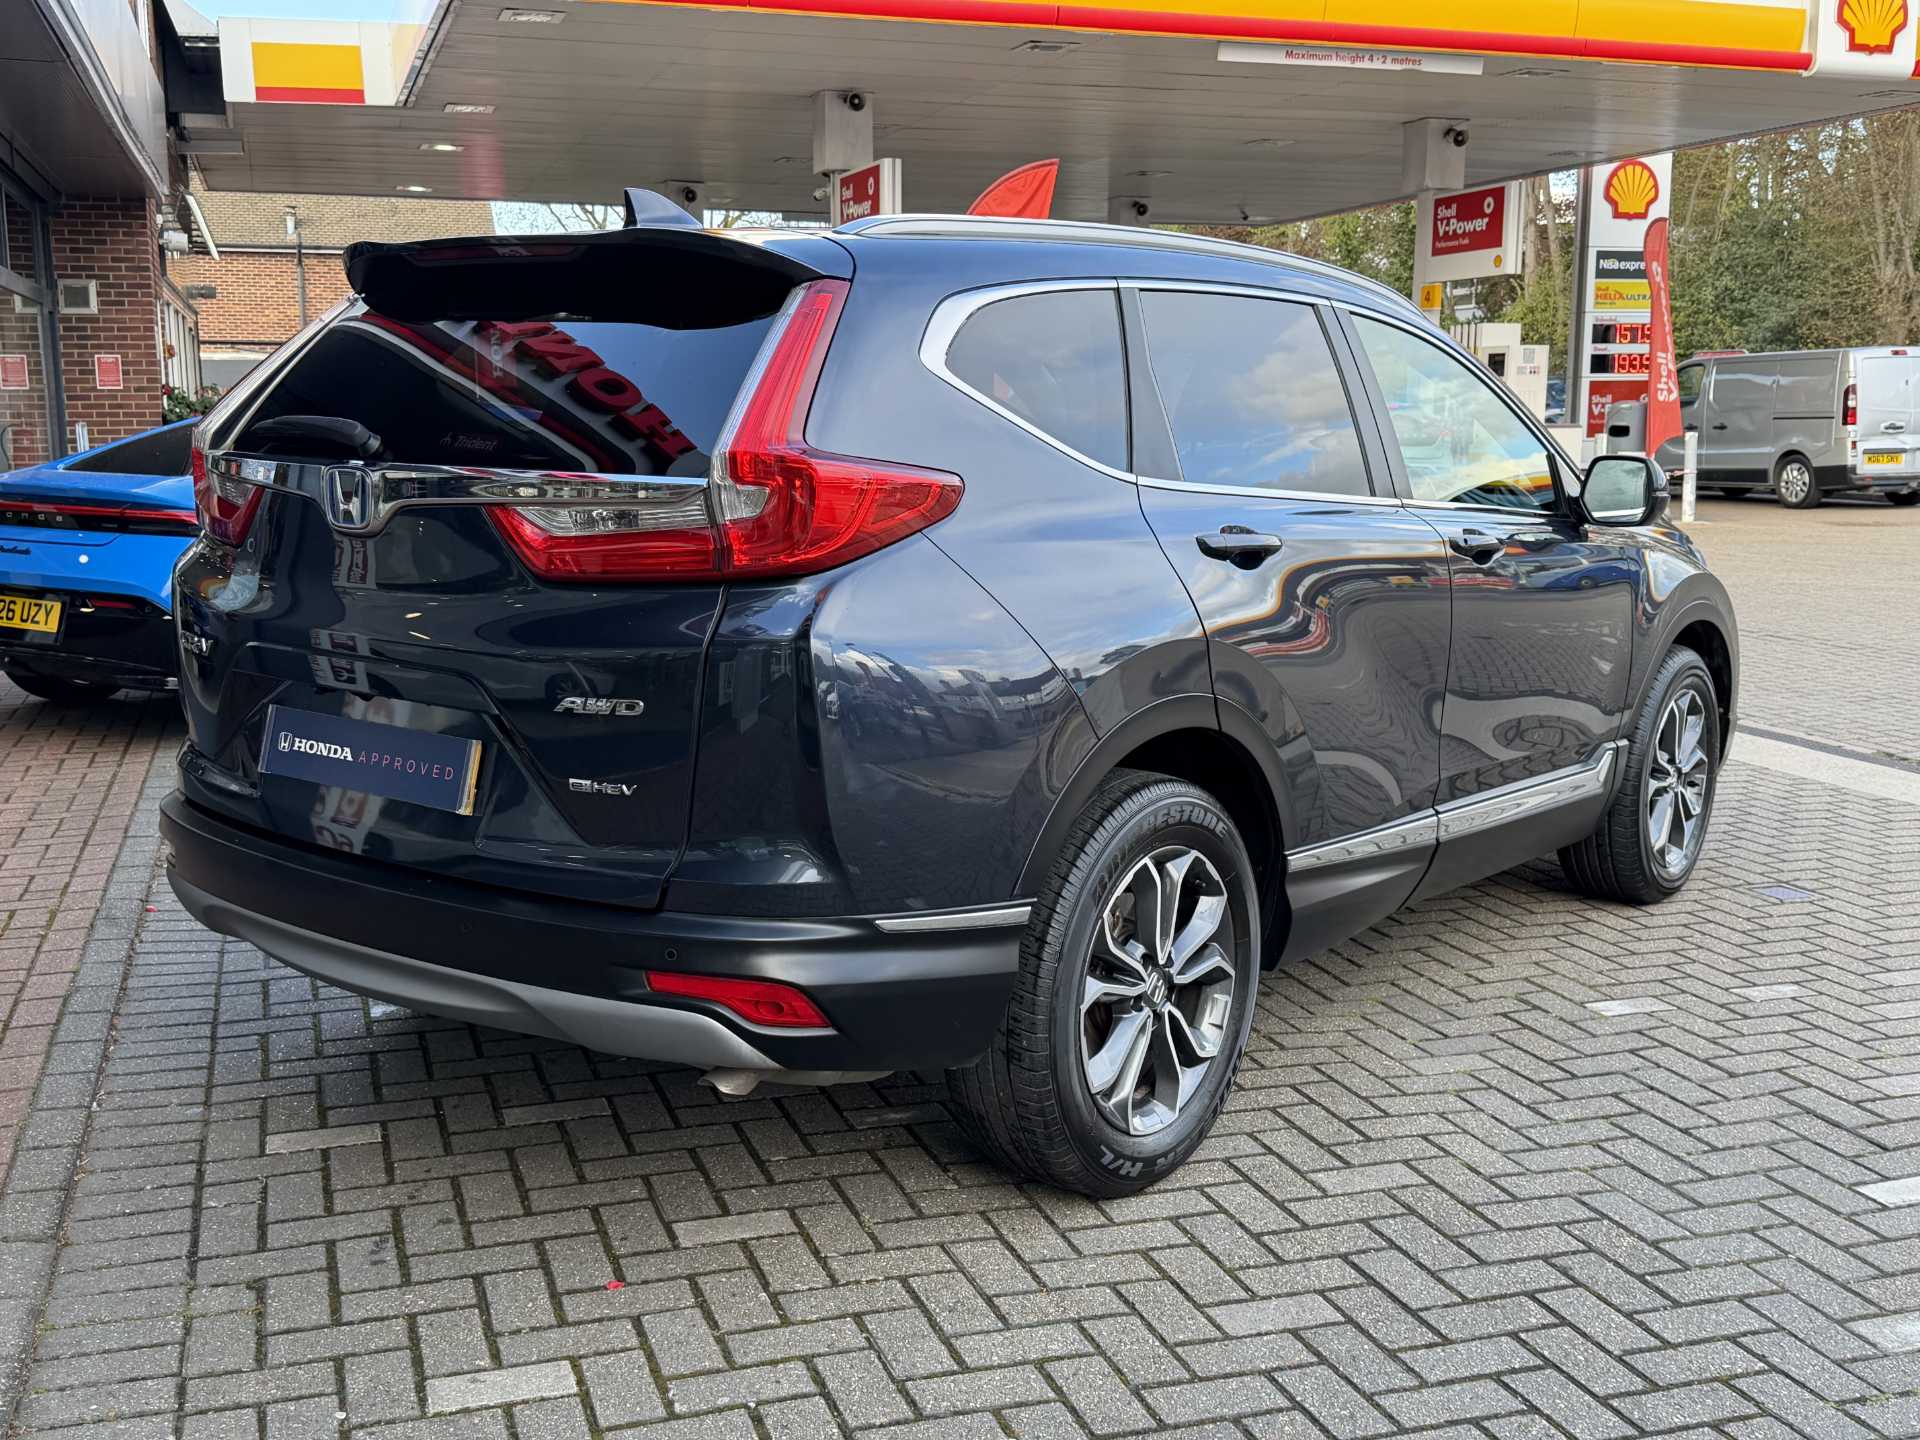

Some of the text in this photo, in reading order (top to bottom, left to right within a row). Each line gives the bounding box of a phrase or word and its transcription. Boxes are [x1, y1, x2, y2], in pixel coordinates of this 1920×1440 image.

[1284, 49, 1333, 62] Maximum
[1335, 51, 1366, 65] height
[1390, 57, 1423, 66] metres
[1437, 203, 1457, 219] Shell
[1437, 217, 1489, 238] V-Power
[1423, 289, 1431, 303] 4
[1656, 351, 1669, 403] Shell
[1591, 393, 1613, 404] Shell
[20, 601, 55, 627] UZY
[553, 696, 645, 717] AWD
[292, 736, 455, 781] HONDA APPROVED
